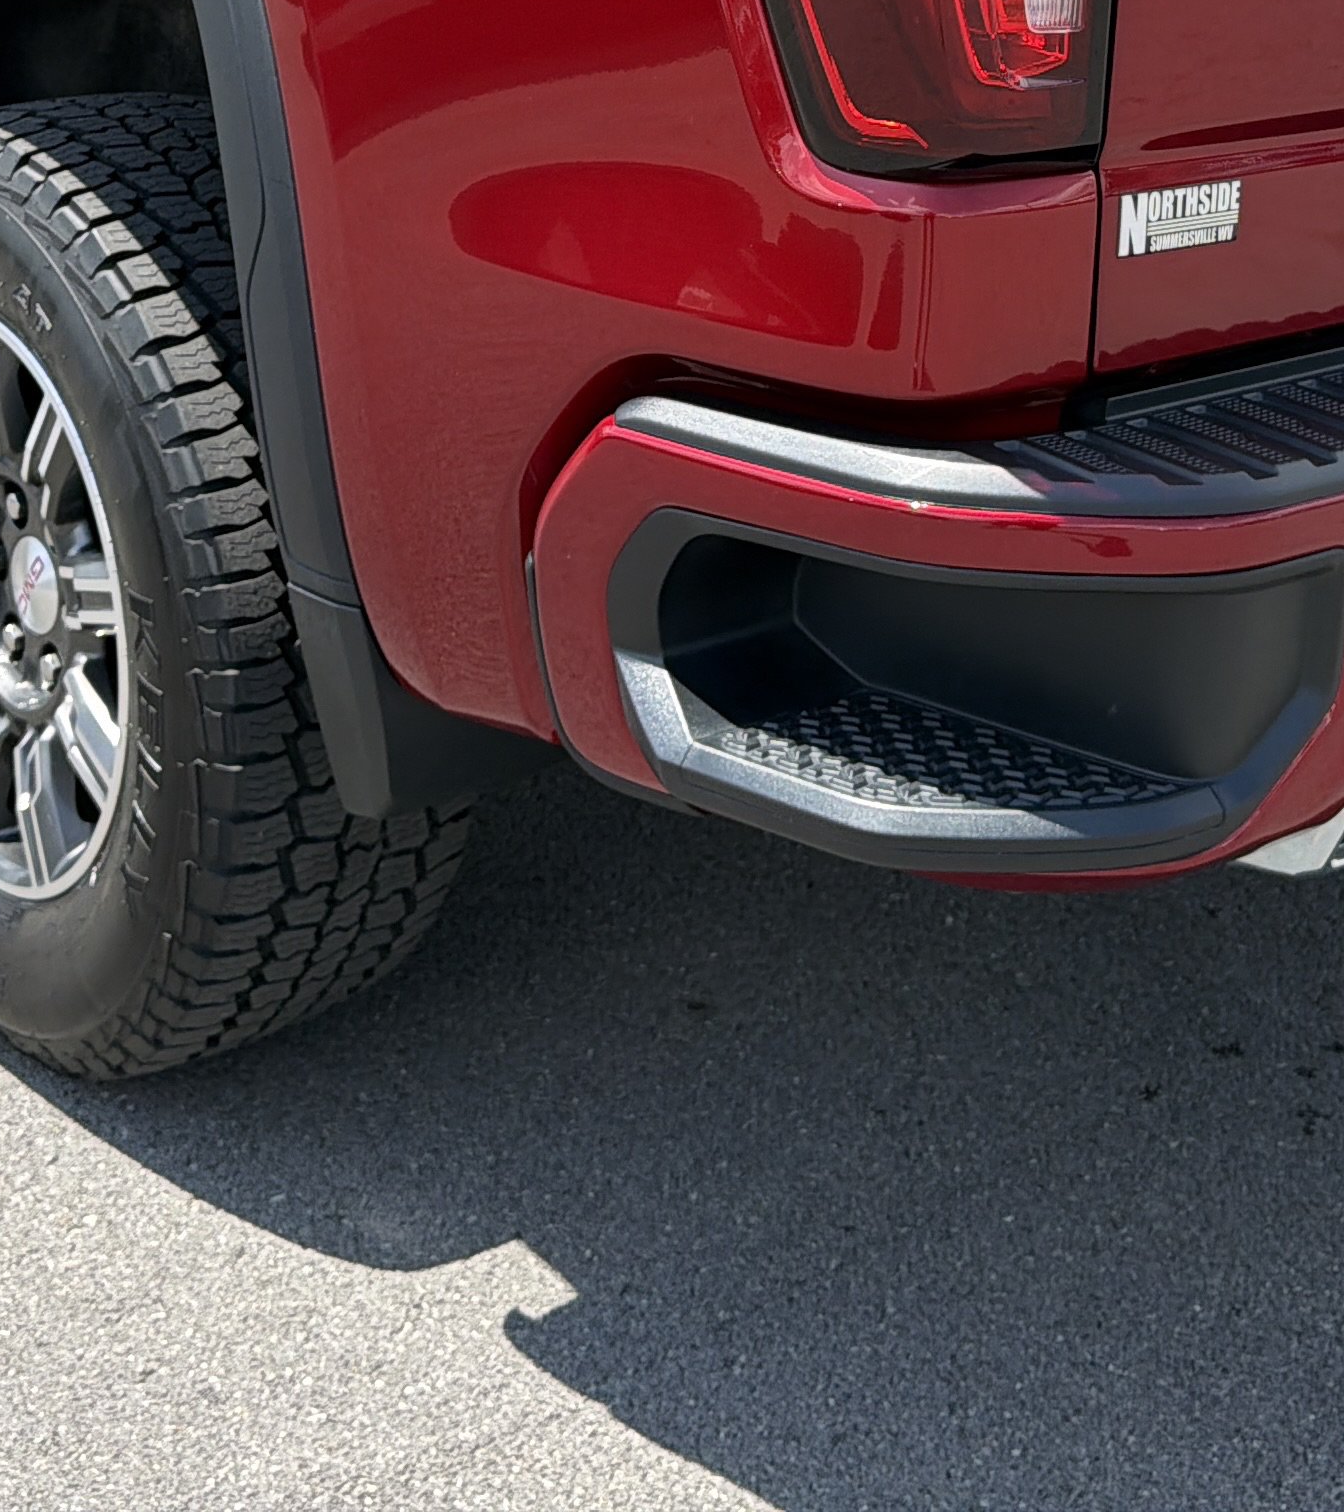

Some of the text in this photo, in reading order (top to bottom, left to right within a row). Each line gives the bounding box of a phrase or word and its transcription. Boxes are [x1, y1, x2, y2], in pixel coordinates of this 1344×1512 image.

[1118, 180, 1241, 257] NORTHSIDE
[1149, 225, 1234, 253] SUMMERSVILLE WV
